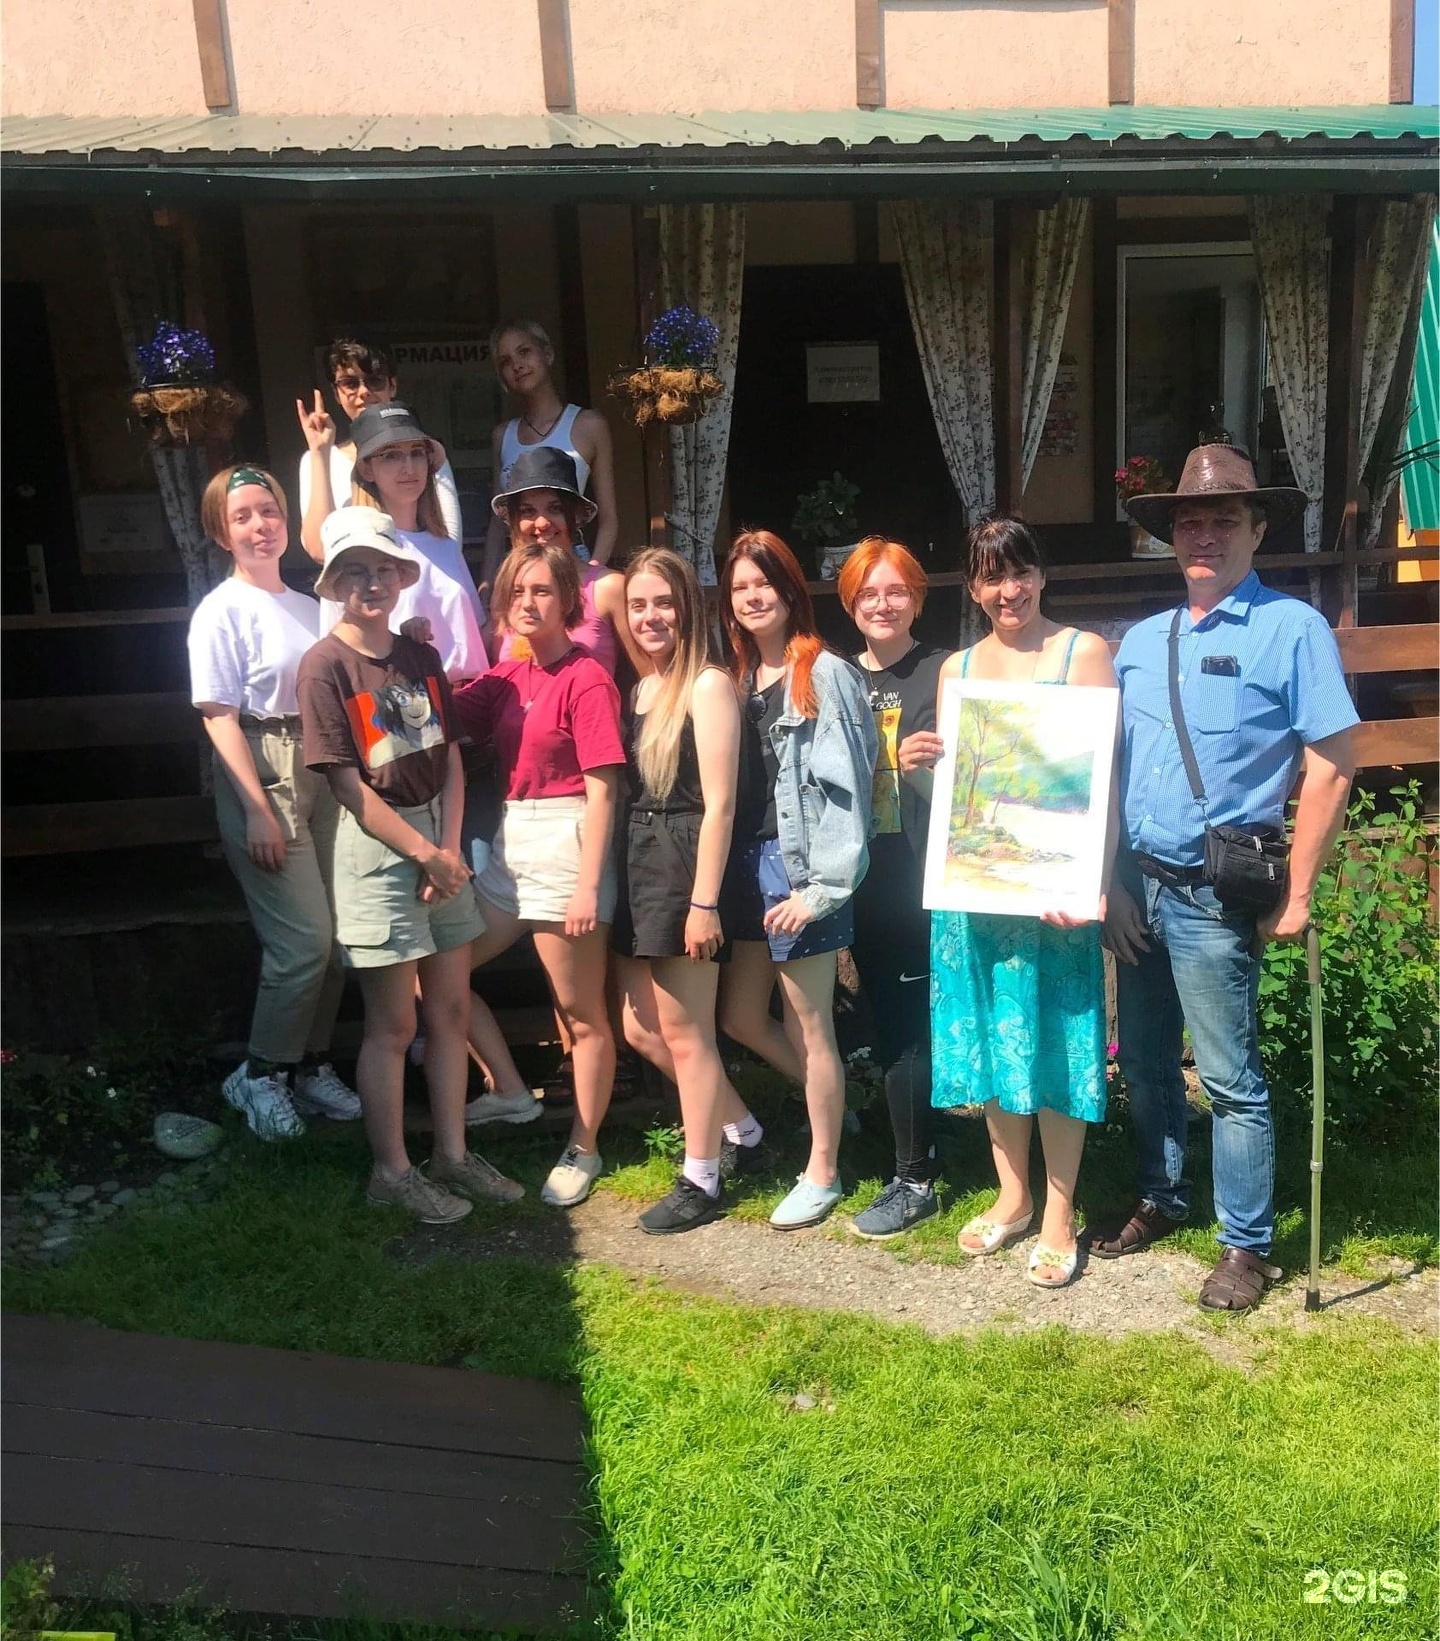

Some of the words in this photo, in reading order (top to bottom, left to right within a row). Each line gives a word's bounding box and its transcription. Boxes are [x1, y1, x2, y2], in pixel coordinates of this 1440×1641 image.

[394, 346, 490, 365] РМАЦИЯ
[883, 691, 900, 701] VAN
[876, 699, 902, 710] GOGH
